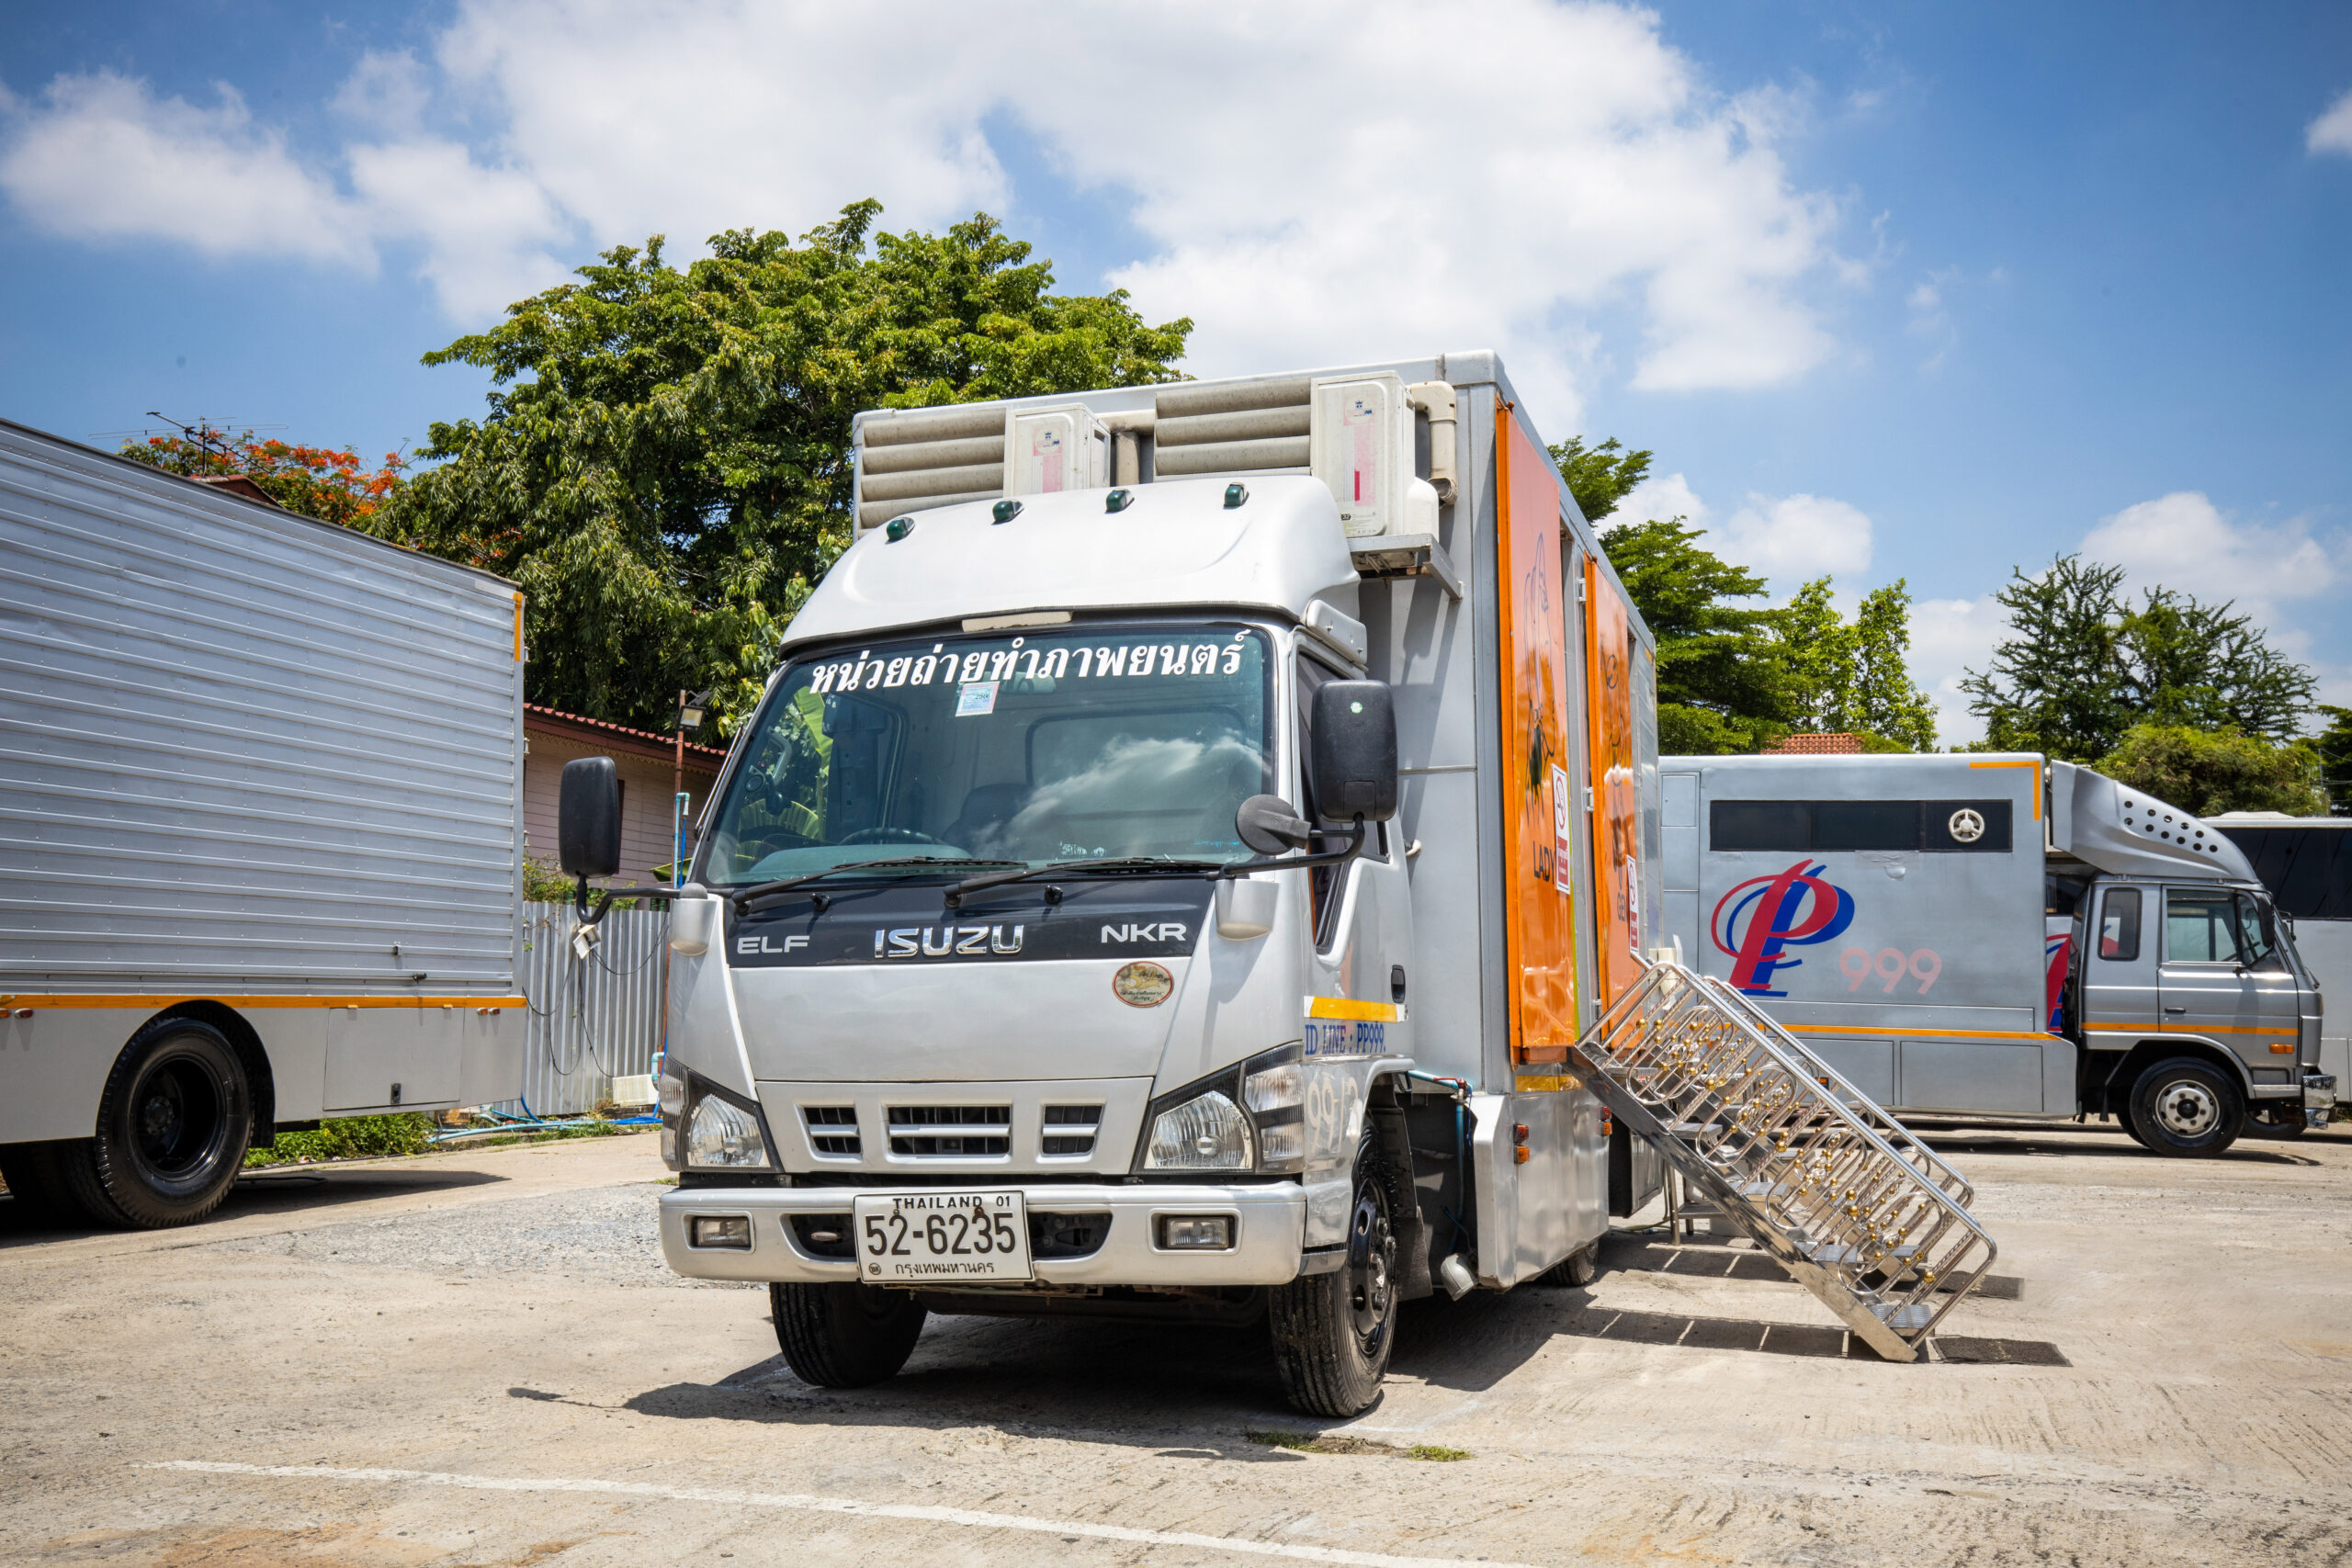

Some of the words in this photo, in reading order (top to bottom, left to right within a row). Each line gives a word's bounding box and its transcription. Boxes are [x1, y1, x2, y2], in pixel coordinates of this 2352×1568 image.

[809, 629, 1252, 694] หน่วยถ่ายทำภาพยนตร์
[736, 935, 809, 954] ELF
[874, 925, 1024, 958] ISUZU
[1101, 923, 1187, 943] NKR
[1839, 947, 1943, 995] 999
[1305, 1024, 1318, 1055] ID
[1322, 1025, 1347, 1055] LINE
[893, 1196, 983, 1210] THAILAND
[996, 1196, 1011, 1207] 01
[865, 1212, 1016, 1256] 52-6235
[895, 1261, 995, 1278] กรุงเทพมหานคร
